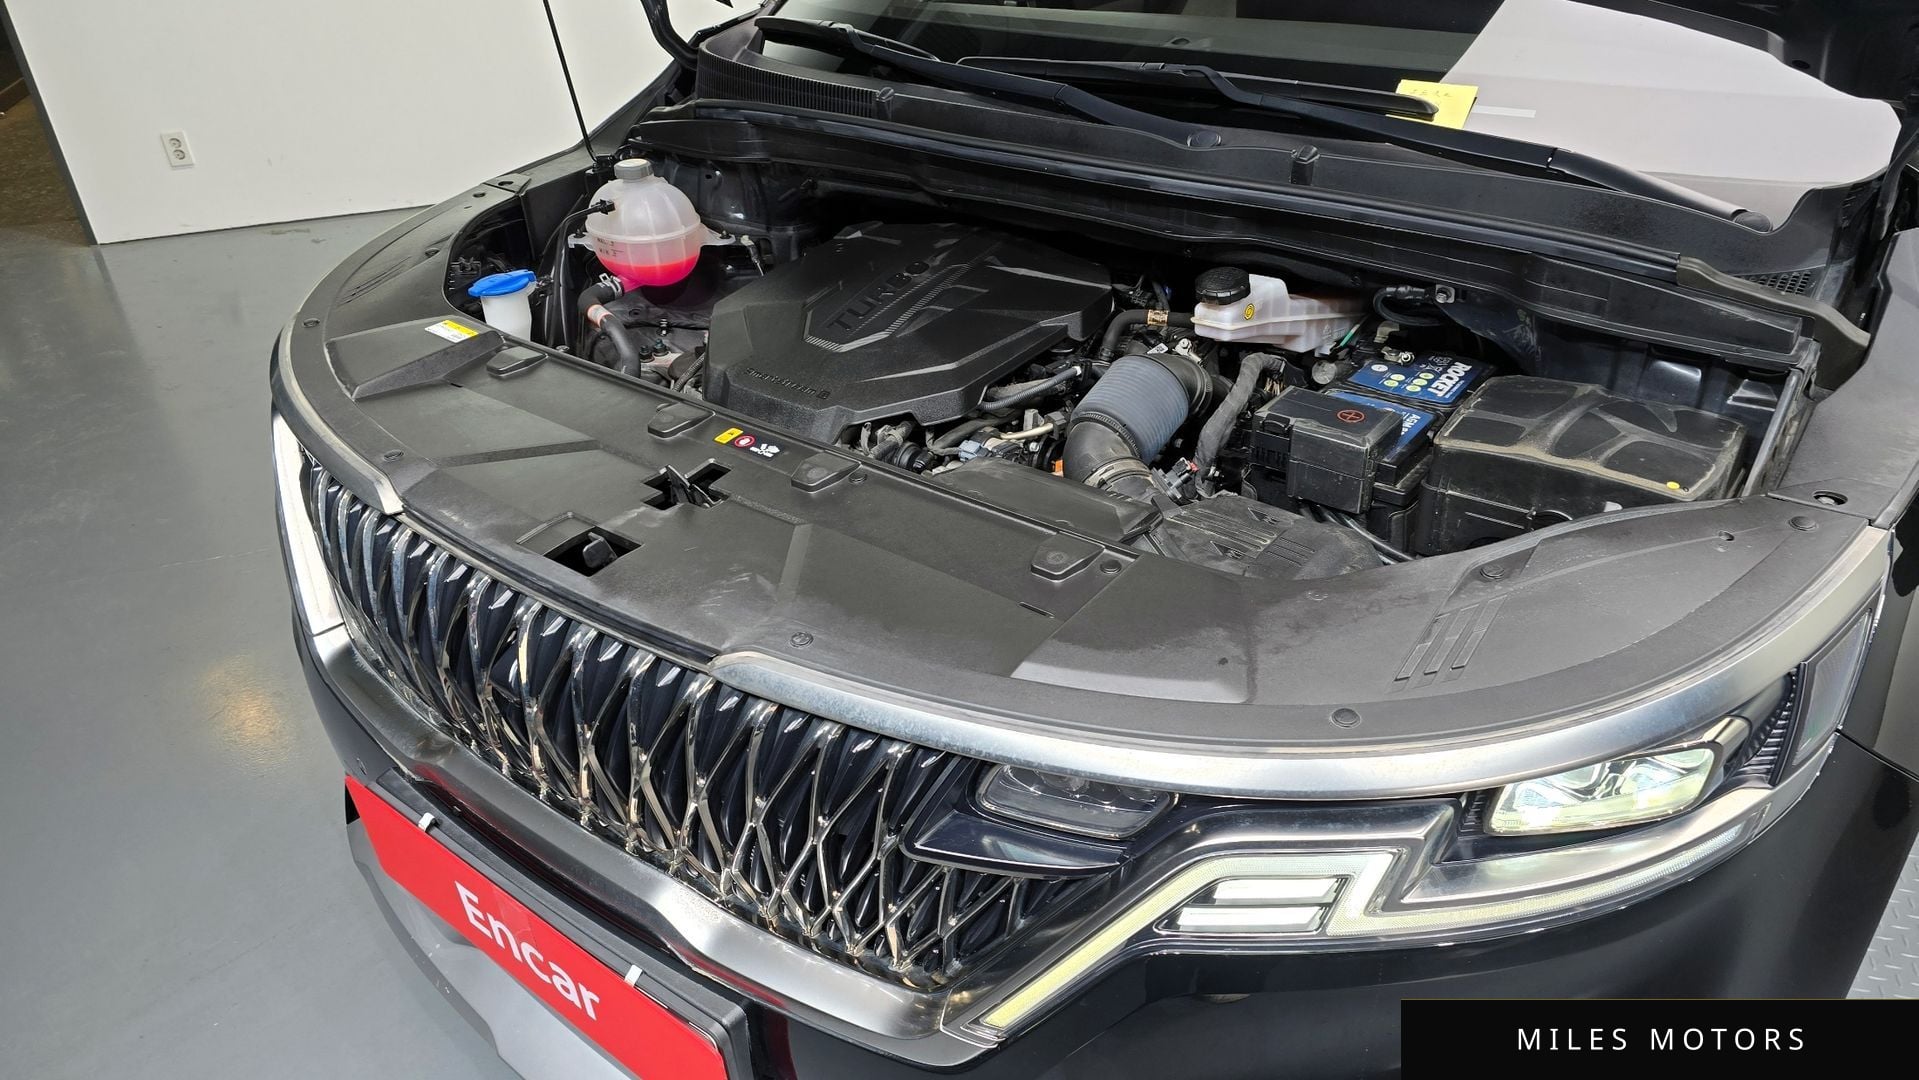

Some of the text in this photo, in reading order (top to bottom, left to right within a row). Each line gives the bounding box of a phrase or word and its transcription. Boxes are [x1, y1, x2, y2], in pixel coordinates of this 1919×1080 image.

[826, 260, 930, 331] TURBO
[1427, 361, 1473, 397] ROCKET
[454, 880, 600, 1021] Encar
